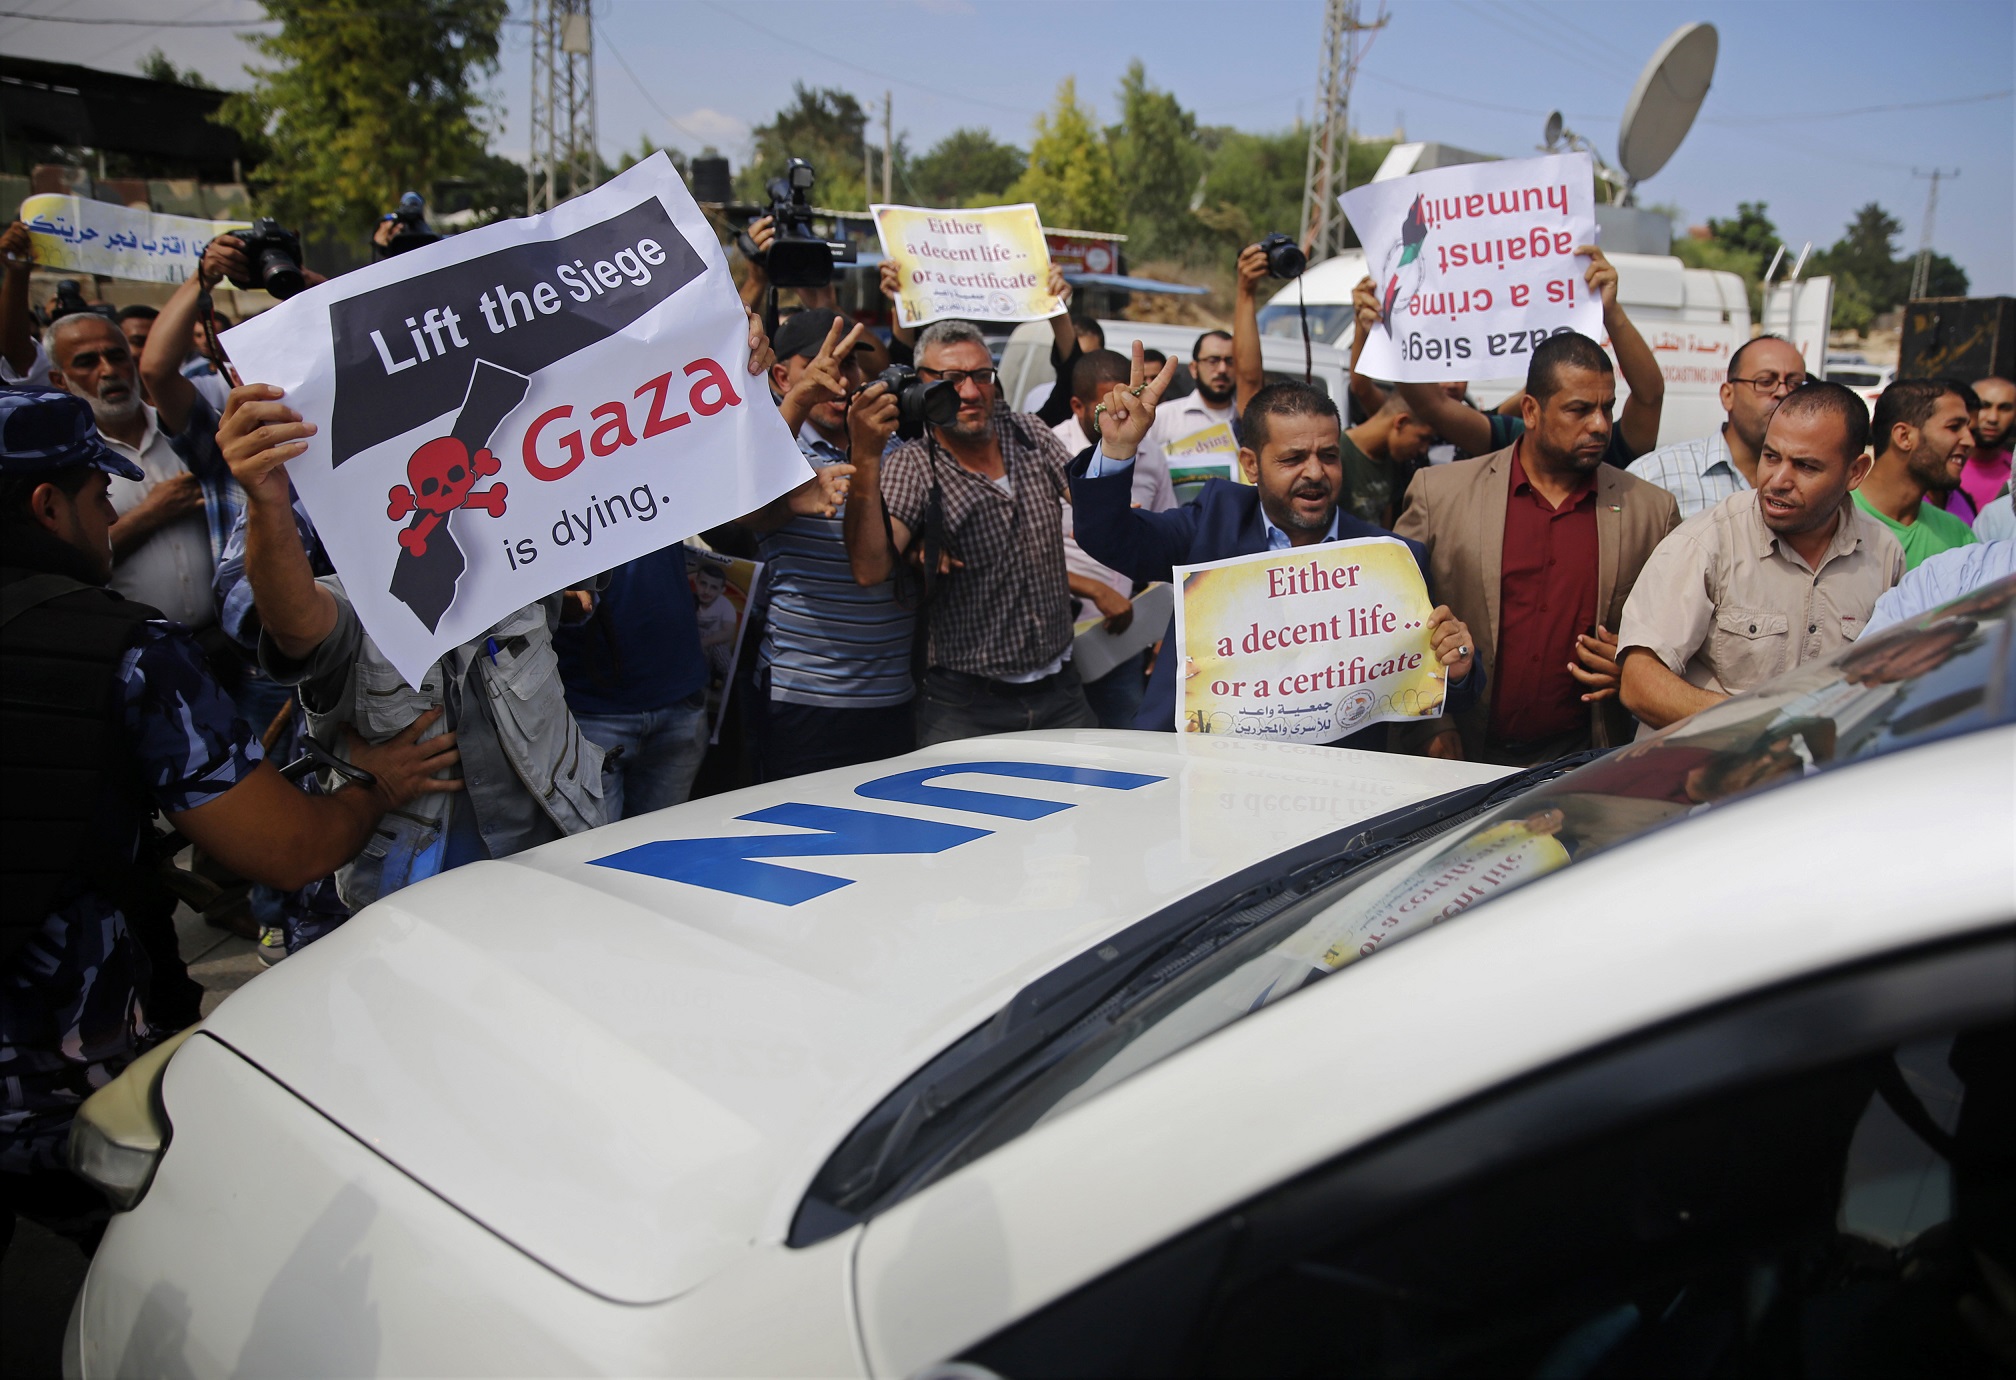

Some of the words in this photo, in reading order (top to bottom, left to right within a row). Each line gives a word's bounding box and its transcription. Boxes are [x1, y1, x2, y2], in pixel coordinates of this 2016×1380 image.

[1415, 184, 1569, 231] humanity
[25, 213, 99, 244] حريتك
[105, 231, 138, 252] فجر
[927, 216, 983, 235] Either
[907, 243, 918, 255] a
[920, 240, 978, 262] decent
[979, 246, 1010, 263] life
[1438, 226, 1573, 275] against
[912, 269, 936, 285] or
[936, 272, 947, 284] a
[950, 272, 1037, 289] certificate
[1546, 279, 1575, 308] is
[369, 305, 469, 376] Lift
[479, 281, 562, 334] the
[556, 238, 667, 303] Siege
[1409, 288, 1493, 322] crime
[1510, 284, 1530, 307] a
[1401, 331, 1472, 367] siege
[1488, 326, 1577, 357] aza
[522, 357, 742, 482] Gaza
[503, 538, 538, 571] is
[552, 484, 670, 547] dying.
[1266, 560, 1360, 599] Either
[1217, 636, 1235, 657] a
[1242, 615, 1341, 655] decent
[1348, 603, 1397, 638] life
[1211, 679, 1246, 698] or
[1253, 679, 1271, 698] a
[1278, 652, 1422, 698] certificate
[1235, 721, 1288, 736] والمحررين
[1238, 706, 1275, 719] واعد
[1290, 718, 1331, 735] للأسرى
[584, 761, 1169, 907] UN
